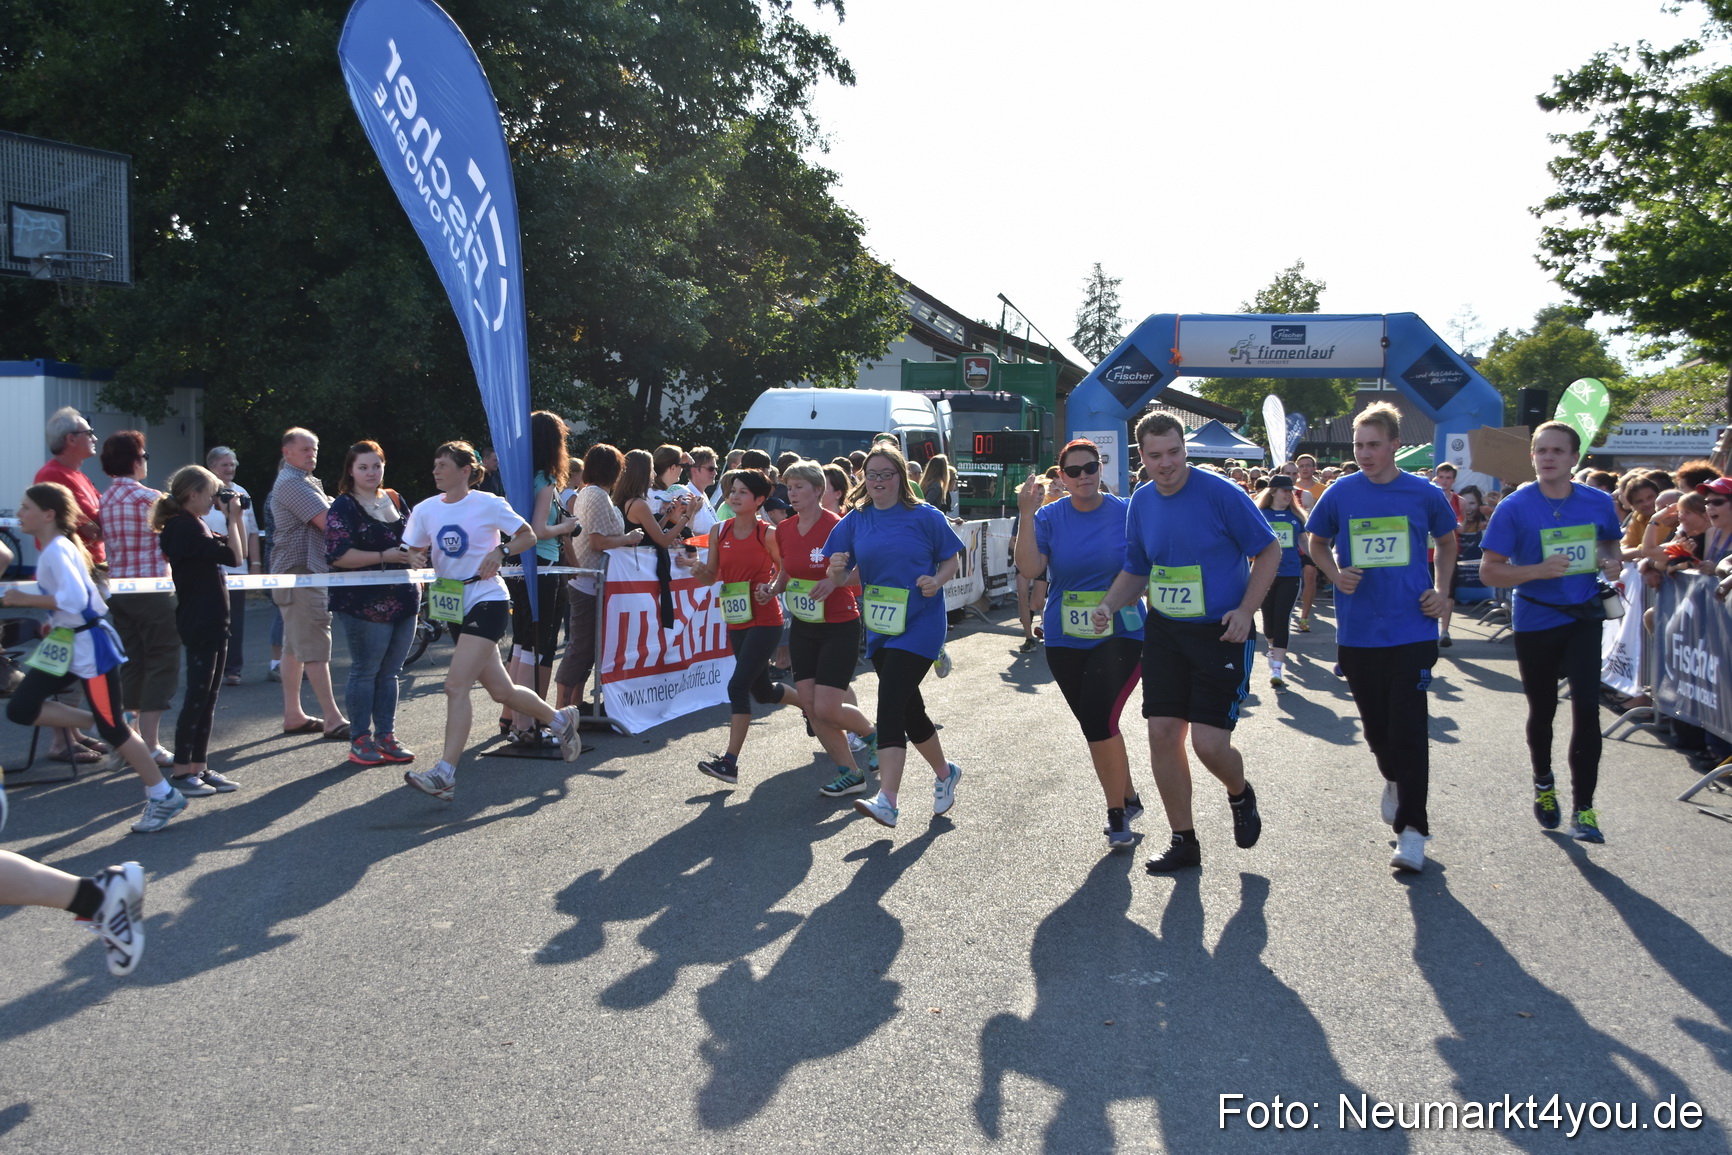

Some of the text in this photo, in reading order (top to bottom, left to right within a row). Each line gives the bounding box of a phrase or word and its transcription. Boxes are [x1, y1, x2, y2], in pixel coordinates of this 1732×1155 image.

[1258, 345, 1336, 359] firmenlauf
[1113, 371, 1154, 380] Fischer
[1617, 427, 1648, 436] Jura
[1661, 427, 1709, 437] Hallen
[975, 434, 993, 454] 00
[1362, 537, 1397, 554] 737
[432, 594, 460, 611] 1487
[793, 595, 816, 612] 198
[1158, 587, 1192, 604] 772
[722, 598, 747, 613] 1380
[871, 604, 897, 621] 777
[1070, 610, 1089, 626] 81
[1672, 632, 1719, 685] Fischer
